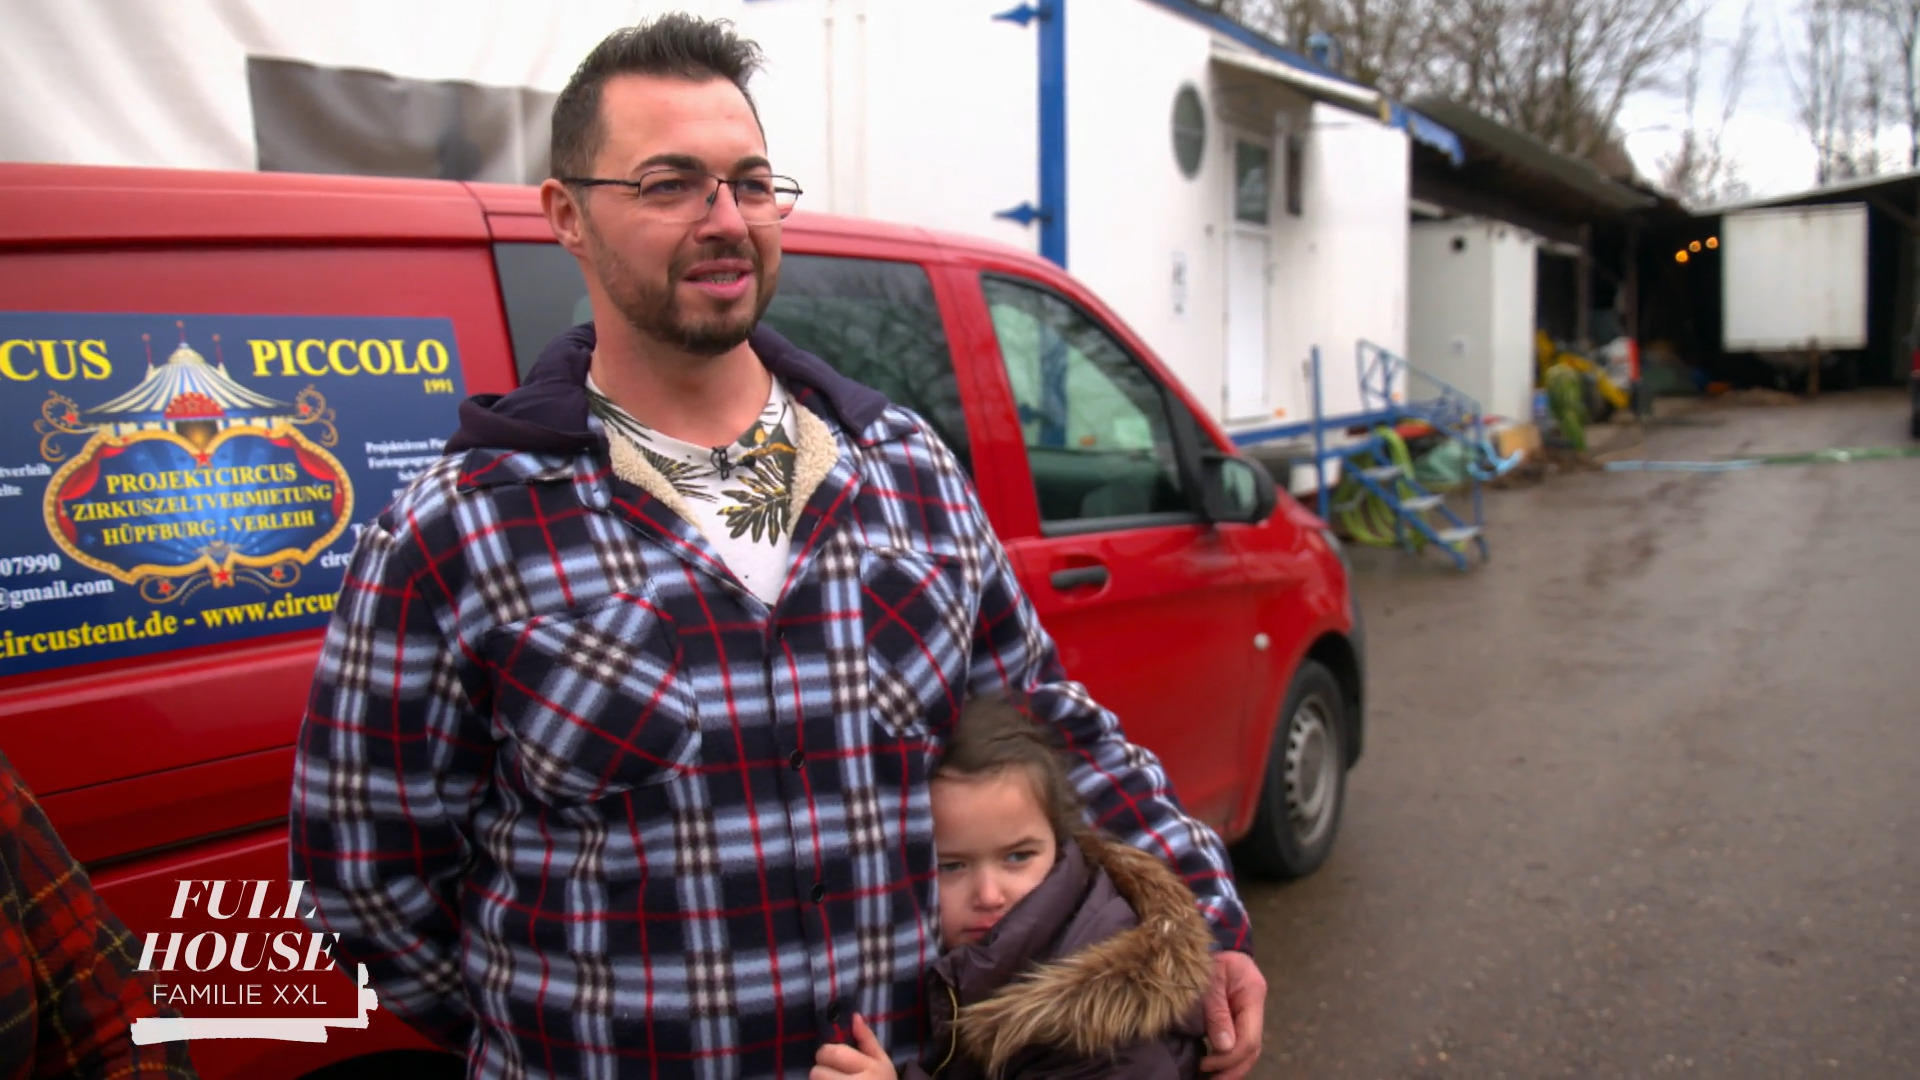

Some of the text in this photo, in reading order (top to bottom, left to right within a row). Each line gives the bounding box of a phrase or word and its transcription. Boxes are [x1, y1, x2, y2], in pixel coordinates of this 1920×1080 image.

[247, 338, 449, 376] PICCOLO
[424, 378, 453, 394] 1991
[106, 463, 297, 494] PROJEKTCIRCUS
[72, 484, 332, 521] ZIRKUSZELTVERMIETUNG
[102, 520, 216, 546] HÜPFBURG
[230, 510, 315, 532] VERLEIH
[0, 553, 60, 576] 07990
